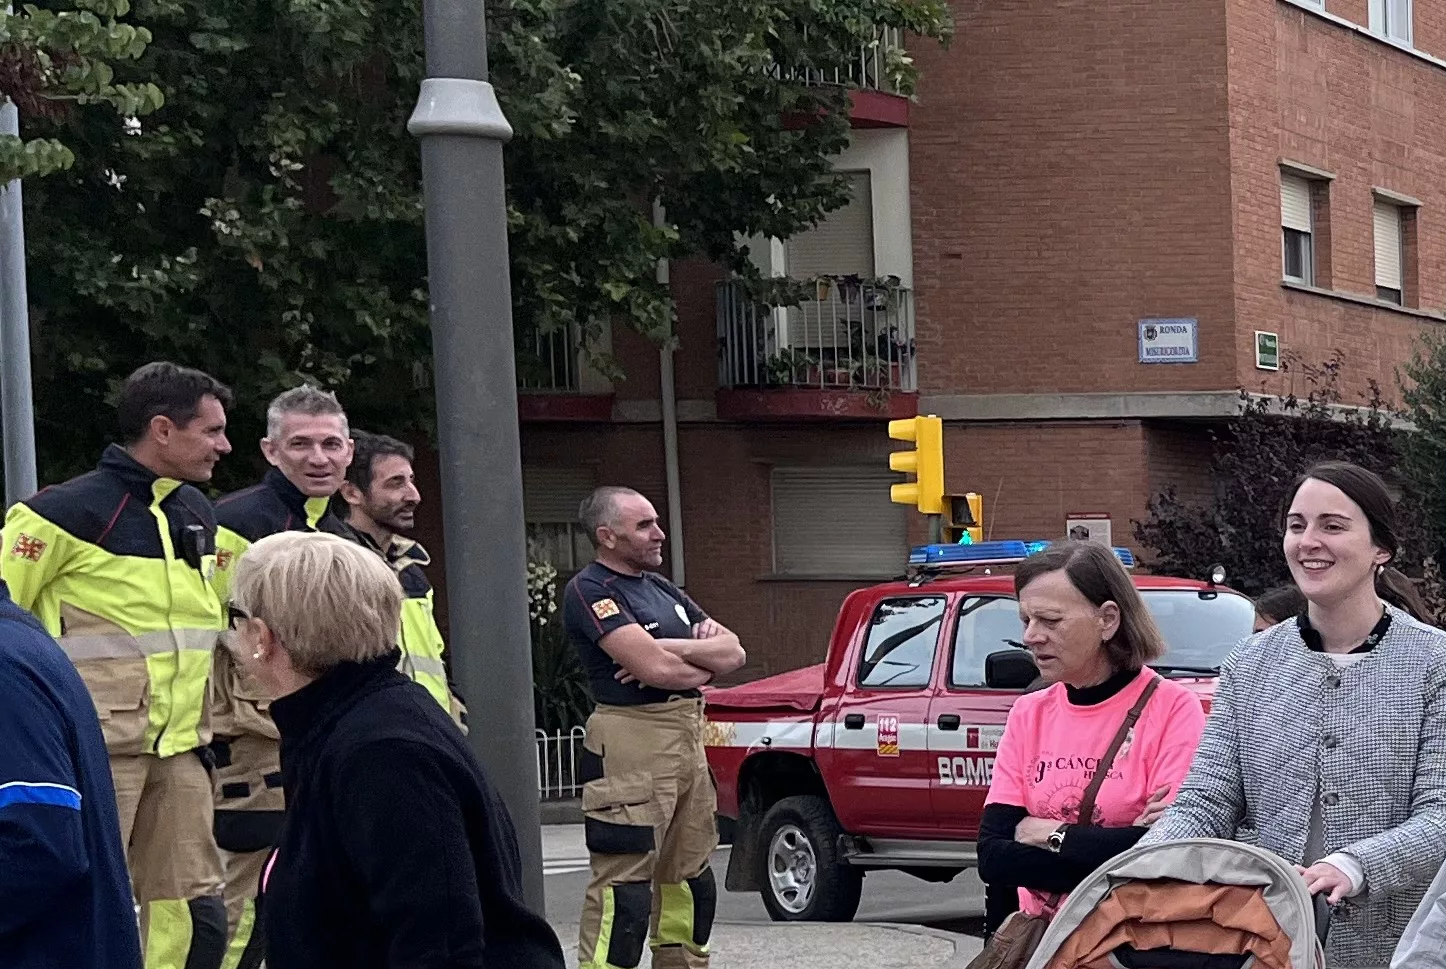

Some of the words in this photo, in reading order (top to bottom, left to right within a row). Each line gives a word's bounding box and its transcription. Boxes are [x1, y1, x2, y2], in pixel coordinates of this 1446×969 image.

[1159, 325, 1188, 334] RONDA
[880, 717, 897, 732] 112
[1055, 754, 1114, 770] CÁNC
